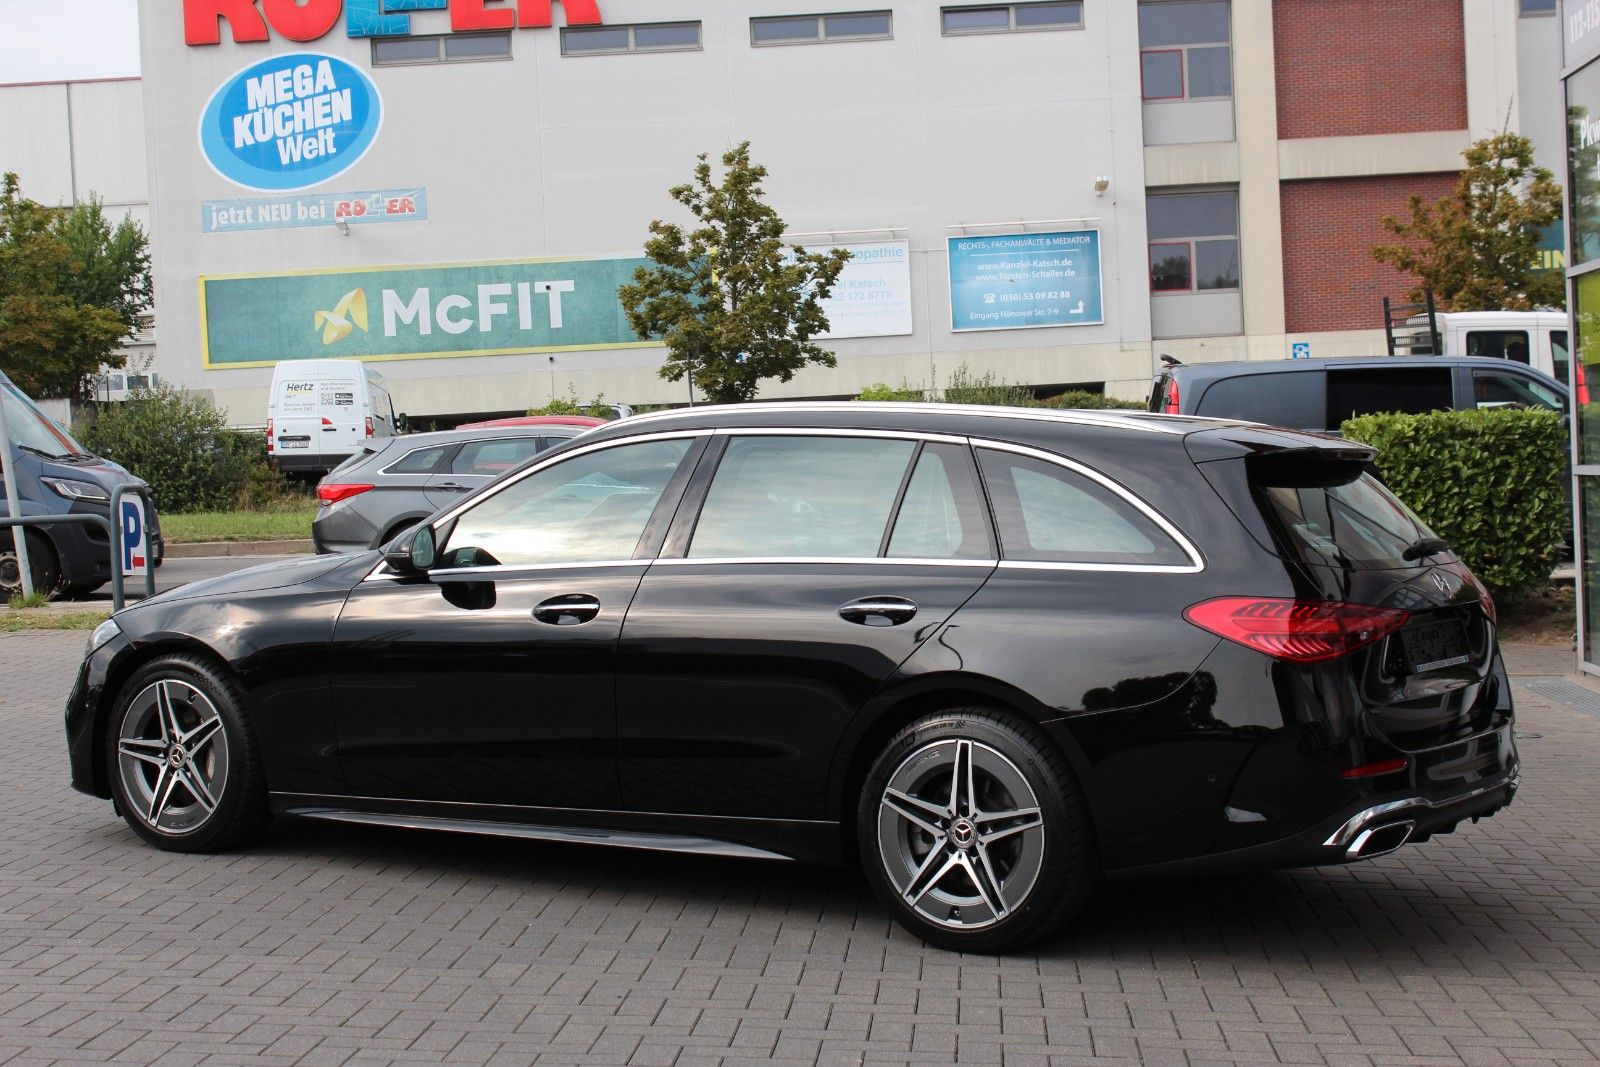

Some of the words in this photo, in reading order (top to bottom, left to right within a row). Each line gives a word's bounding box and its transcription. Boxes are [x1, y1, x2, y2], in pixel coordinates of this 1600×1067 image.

[183, 0, 603, 46] ROL
[246, 59, 337, 111] MEGA
[233, 88, 352, 149] KÜCHEN
[276, 127, 337, 165] Welt
[210, 206, 255, 230] jetzt
[258, 203, 292, 222] NEU
[297, 199, 326, 220] bei
[334, 193, 417, 219] ROLLER
[1052, 236, 1090, 245] MEDIATOR
[977, 259, 1073, 270] www.Kanzlei-Katsch.de
[382, 279, 575, 337] McFIT
[1000, 293, 1021, 302] (030)
[1035, 292, 1046, 300] 09
[1047, 291, 1058, 299] 82
[970, 312, 999, 320] Eingang
[286, 383, 314, 392] Hertz
[122, 501, 141, 570] P
